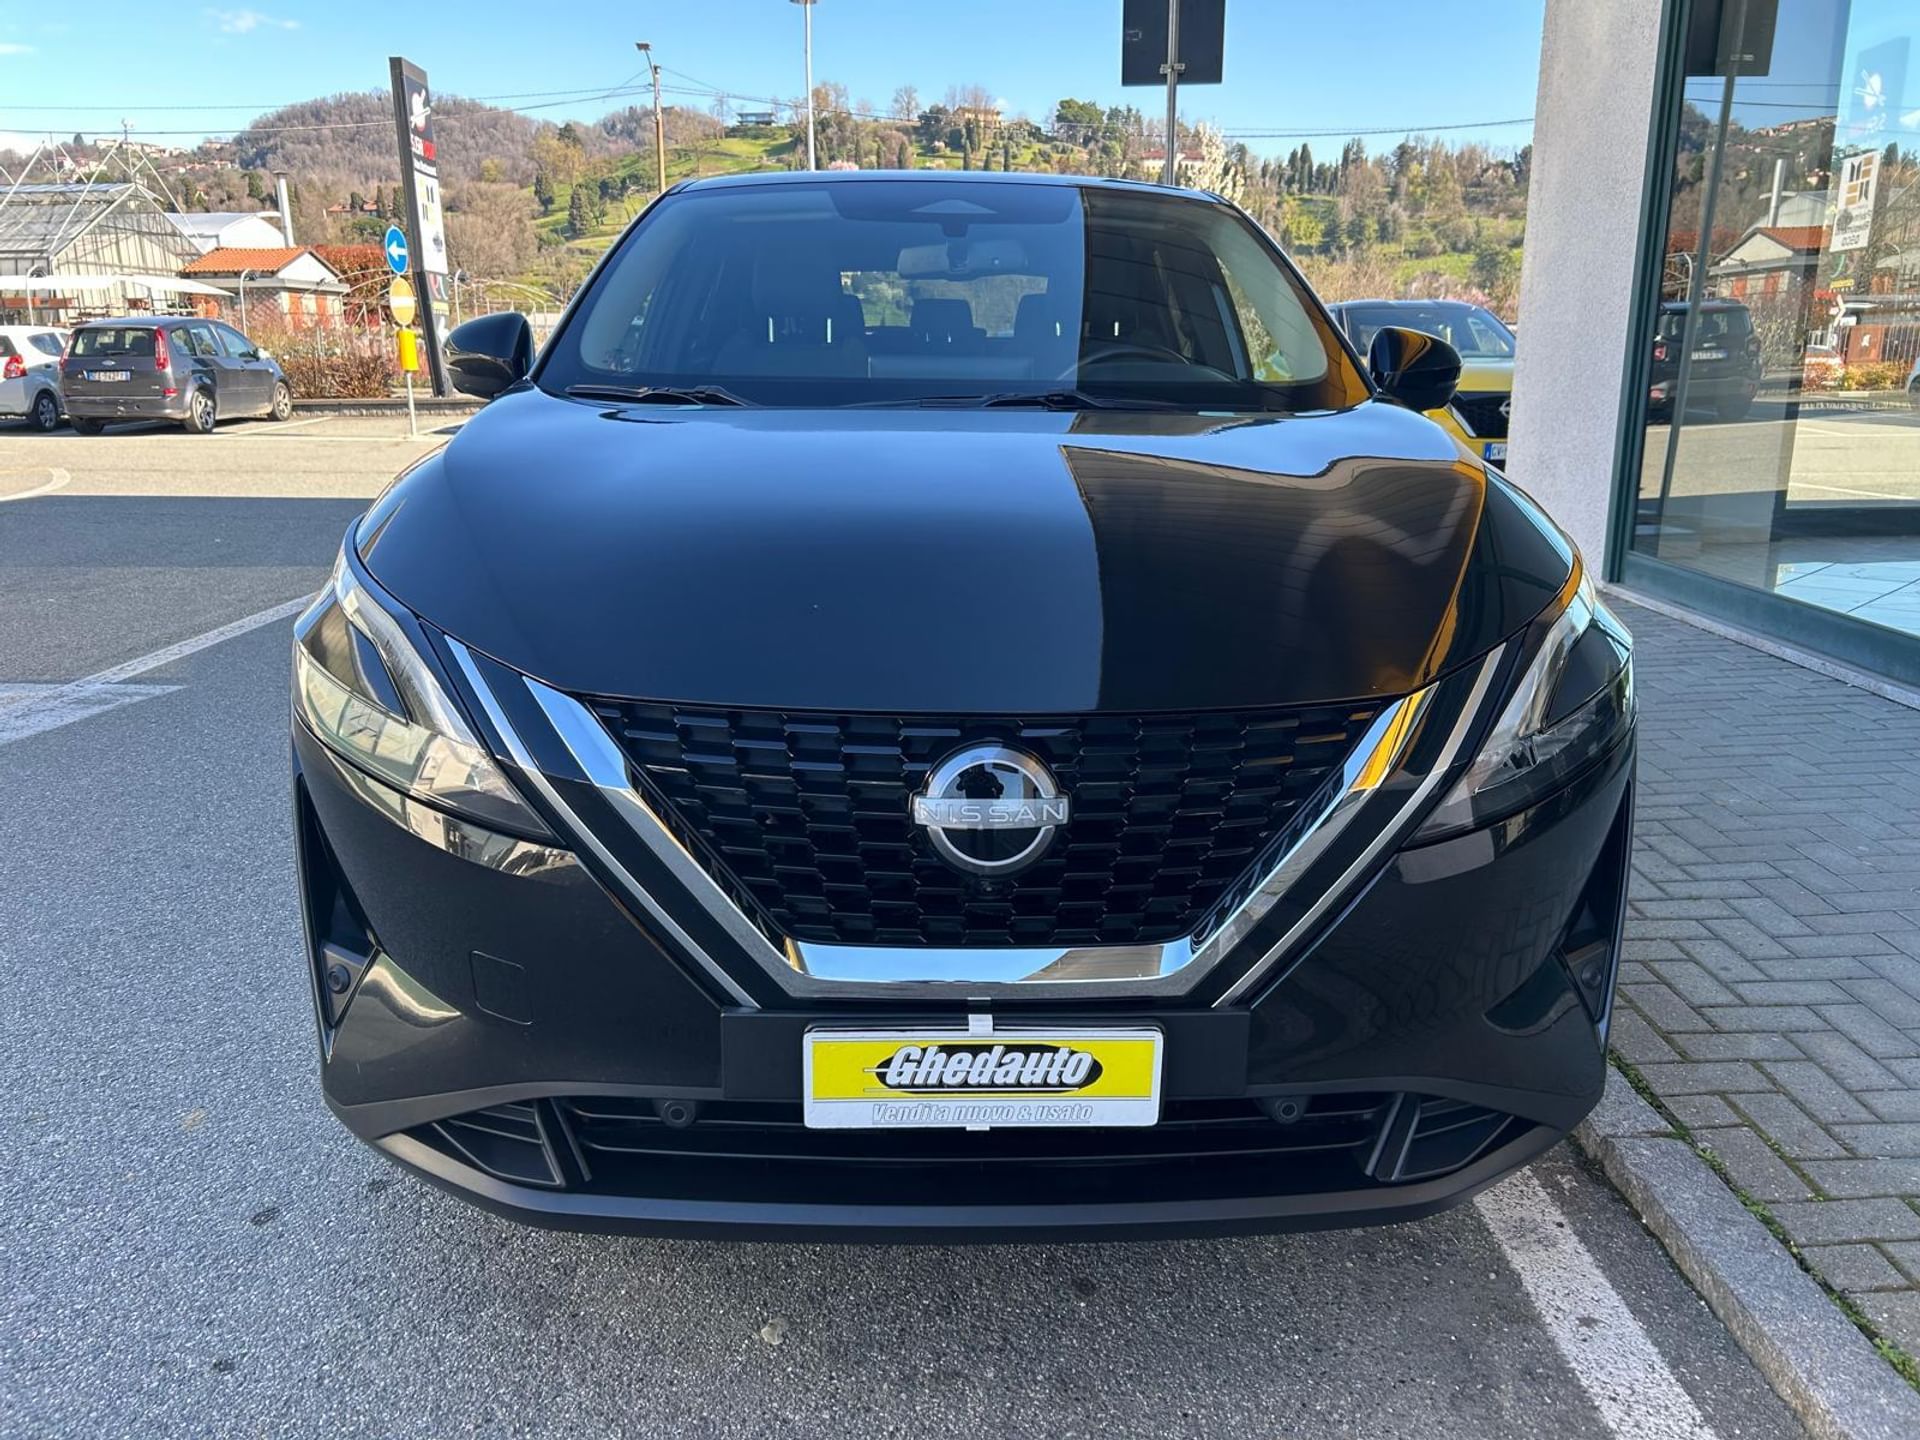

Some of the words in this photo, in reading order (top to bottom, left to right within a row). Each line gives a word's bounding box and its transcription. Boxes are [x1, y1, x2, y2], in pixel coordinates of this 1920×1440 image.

[918, 803, 1064, 823] NISSAN
[884, 1045, 1094, 1087] Ghedauto
[872, 1103, 950, 1121] Vendita
[952, 1106, 1014, 1121] nuovo
[1017, 1105, 1033, 1121] &
[1035, 1104, 1093, 1121] usato
